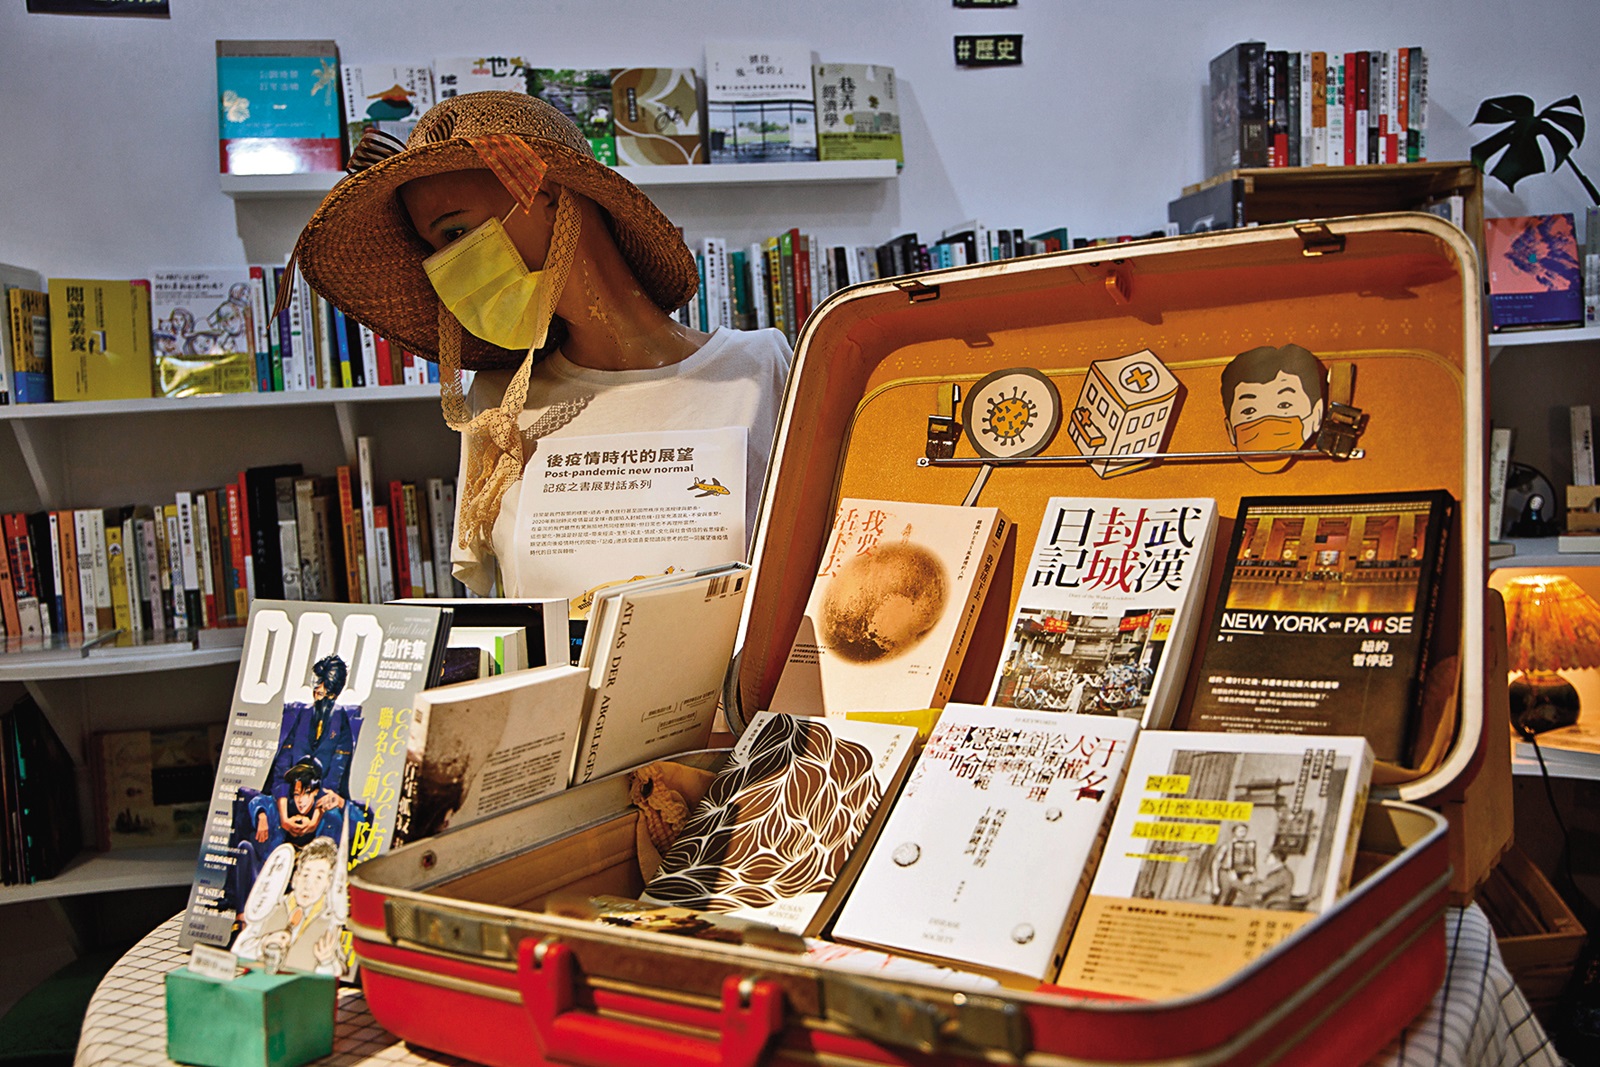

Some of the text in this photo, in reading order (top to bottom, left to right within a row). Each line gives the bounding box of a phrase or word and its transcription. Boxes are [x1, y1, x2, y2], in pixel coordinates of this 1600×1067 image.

[66, 286, 87, 352] 閱讀素養
[546, 447, 695, 468] 後疫情時代的展望
[544, 463, 695, 479] Post-pandemic new normal
[542, 479, 652, 494] 記疫之書展對話系列
[1031, 506, 1096, 588] 日記
[1081, 506, 1151, 594] 封城
[1133, 506, 1203, 593] 武漢
[615, 601, 636, 651] ATLAS
[1220, 612, 1269, 630] NEW
[1273, 614, 1329, 633] YORK
[1329, 620, 1342, 629] on
[382, 637, 428, 661] 創作集
[1361, 639, 1390, 653] 紐約
[379, 660, 423, 672] DOCUMENT ON
[1352, 653, 1394, 667] 暫停記
[377, 669, 412, 681] DEFEATING
[605, 655, 623, 689] DER
[375, 679, 406, 690] DISEASES
[1139, 799, 1247, 819] 為什麼是現在
